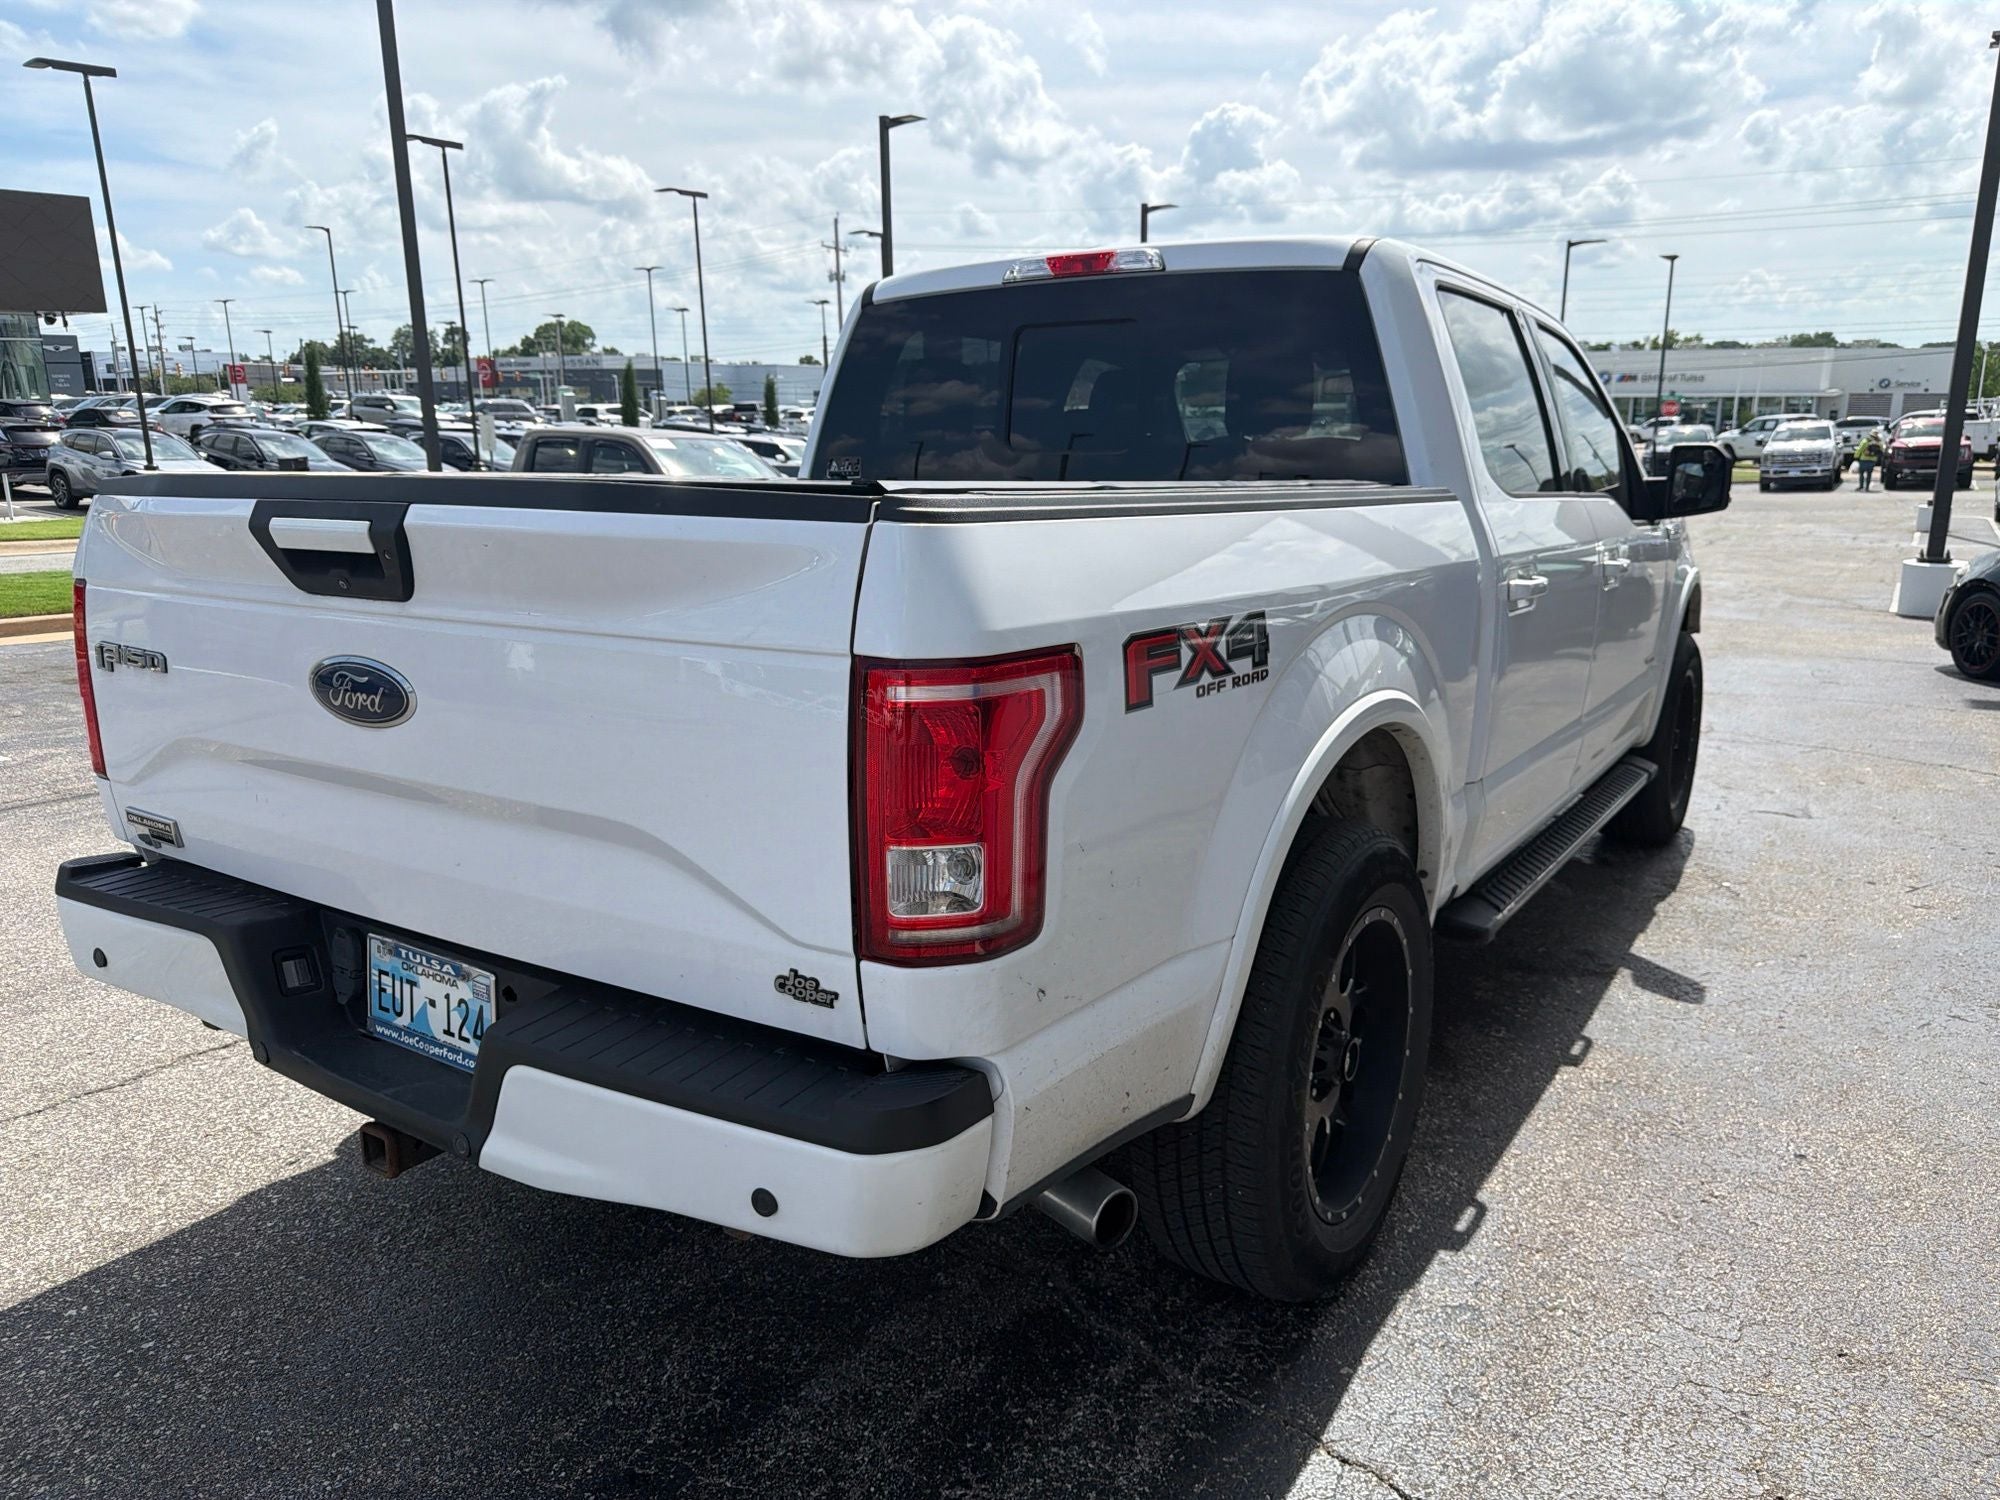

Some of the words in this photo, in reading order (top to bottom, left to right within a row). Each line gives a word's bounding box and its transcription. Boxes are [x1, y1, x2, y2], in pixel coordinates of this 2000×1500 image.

[1680, 374, 1704, 383] Tulsa
[1895, 380, 1921, 388] Service
[1122, 610, 1270, 715] FX4
[329, 670, 384, 713] Ford
[1196, 679, 1227, 698] OFF
[1231, 669, 1269, 689] ROAD
[128, 813, 171, 832] OKLAHOMA
[398, 947, 456, 976] TULSA
[401, 961, 459, 990] OKLAHOMA
[774, 976, 838, 1007] Cooper
[784, 969, 818, 991] Joe
[375, 1024, 477, 1068] www.JoeCooperFord.co
